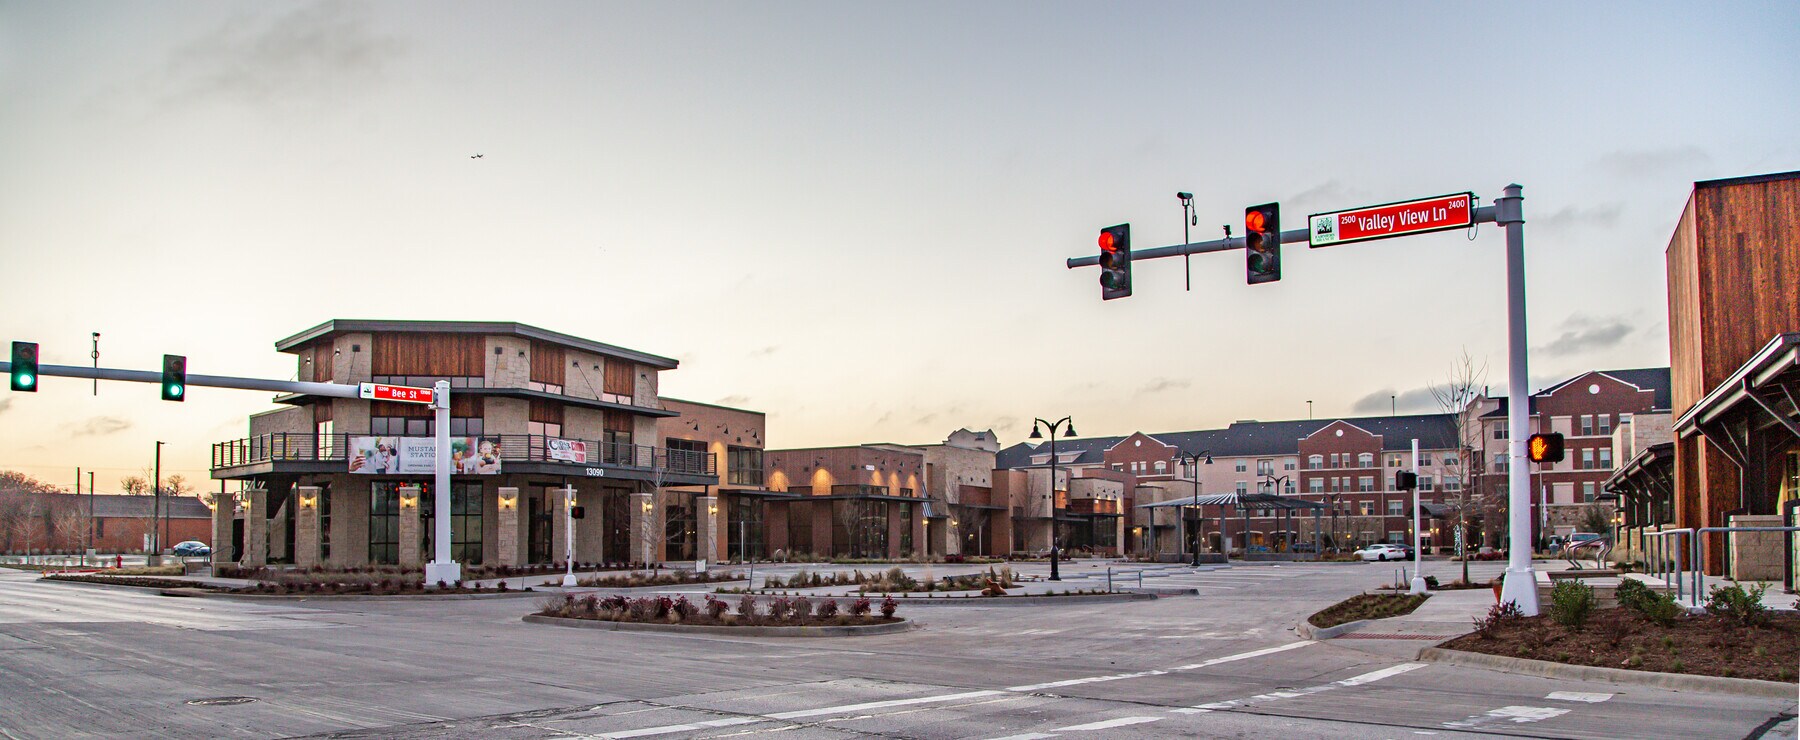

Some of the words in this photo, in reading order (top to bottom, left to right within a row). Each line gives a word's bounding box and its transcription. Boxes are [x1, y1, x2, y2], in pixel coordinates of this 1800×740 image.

[1341, 215, 1356, 225] 2500
[1358, 213, 1395, 232] Valley
[1398, 209, 1429, 226] View
[1432, 206, 1447, 222] Ln
[1448, 199, 1465, 209] 2400
[392, 389, 406, 398] Bee
[409, 390, 417, 399] St
[585, 467, 604, 477] 13090
